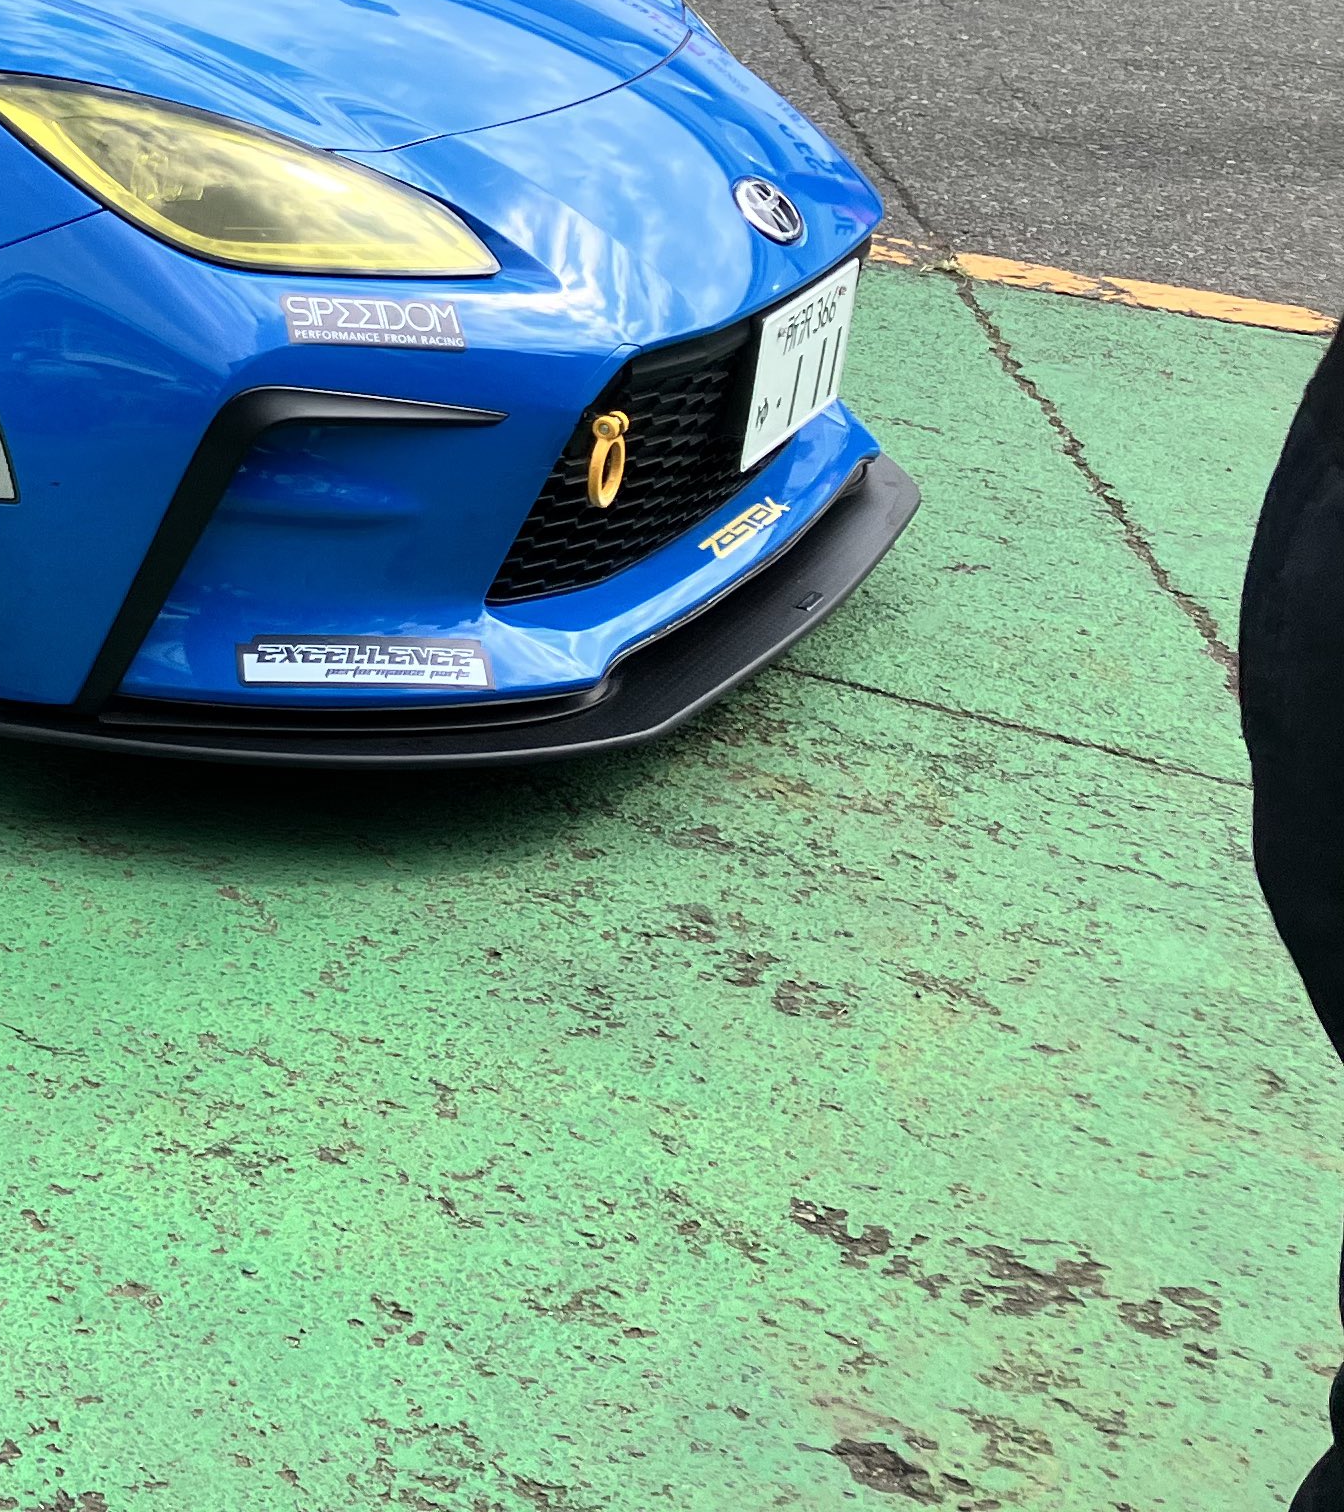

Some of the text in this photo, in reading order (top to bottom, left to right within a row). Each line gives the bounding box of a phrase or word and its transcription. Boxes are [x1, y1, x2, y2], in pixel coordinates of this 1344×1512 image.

[813, 285, 838, 334] 366
[294, 329, 464, 347] PERFORMANCE FROM RACING
[256, 644, 474, 667] EXCELLENCE
[325, 666, 470, 680] performance parts
